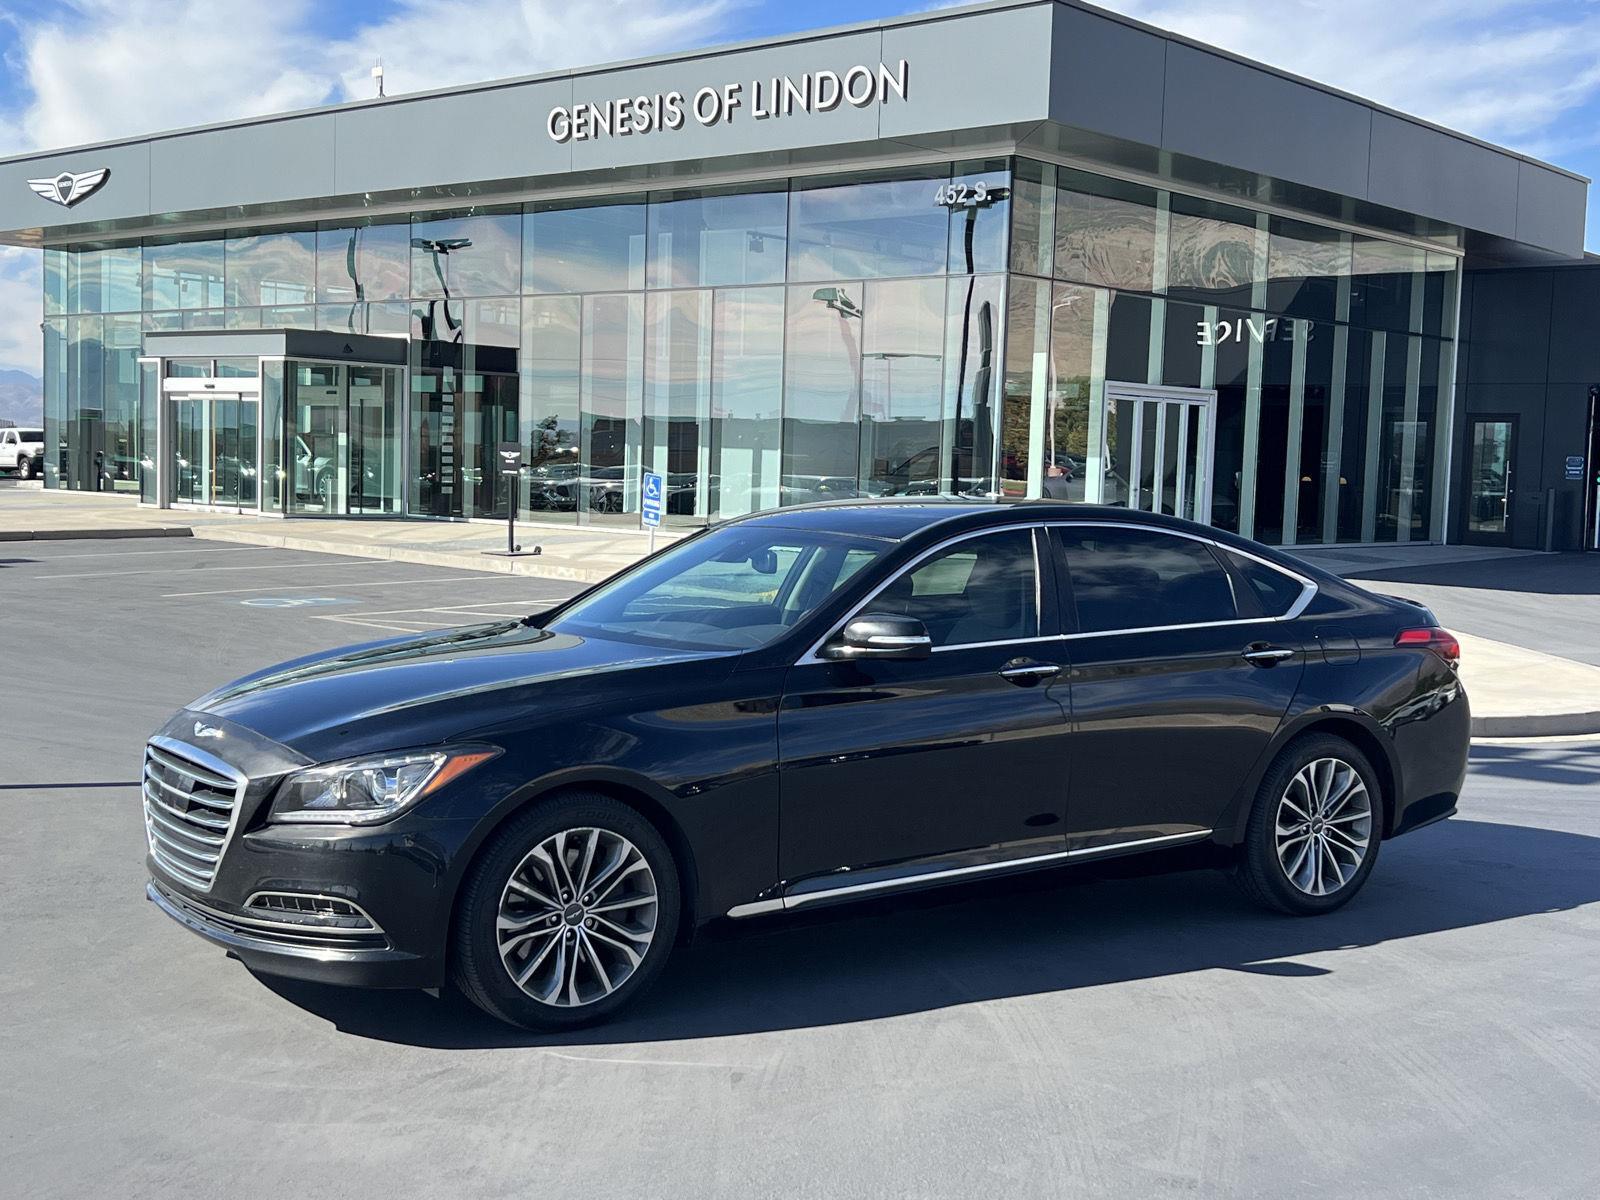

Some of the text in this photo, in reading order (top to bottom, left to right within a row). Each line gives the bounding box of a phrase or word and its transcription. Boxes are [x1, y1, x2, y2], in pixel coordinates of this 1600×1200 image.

[547, 59, 908, 144] GENESIS OF LINDON
[934, 183, 968, 205] 452
